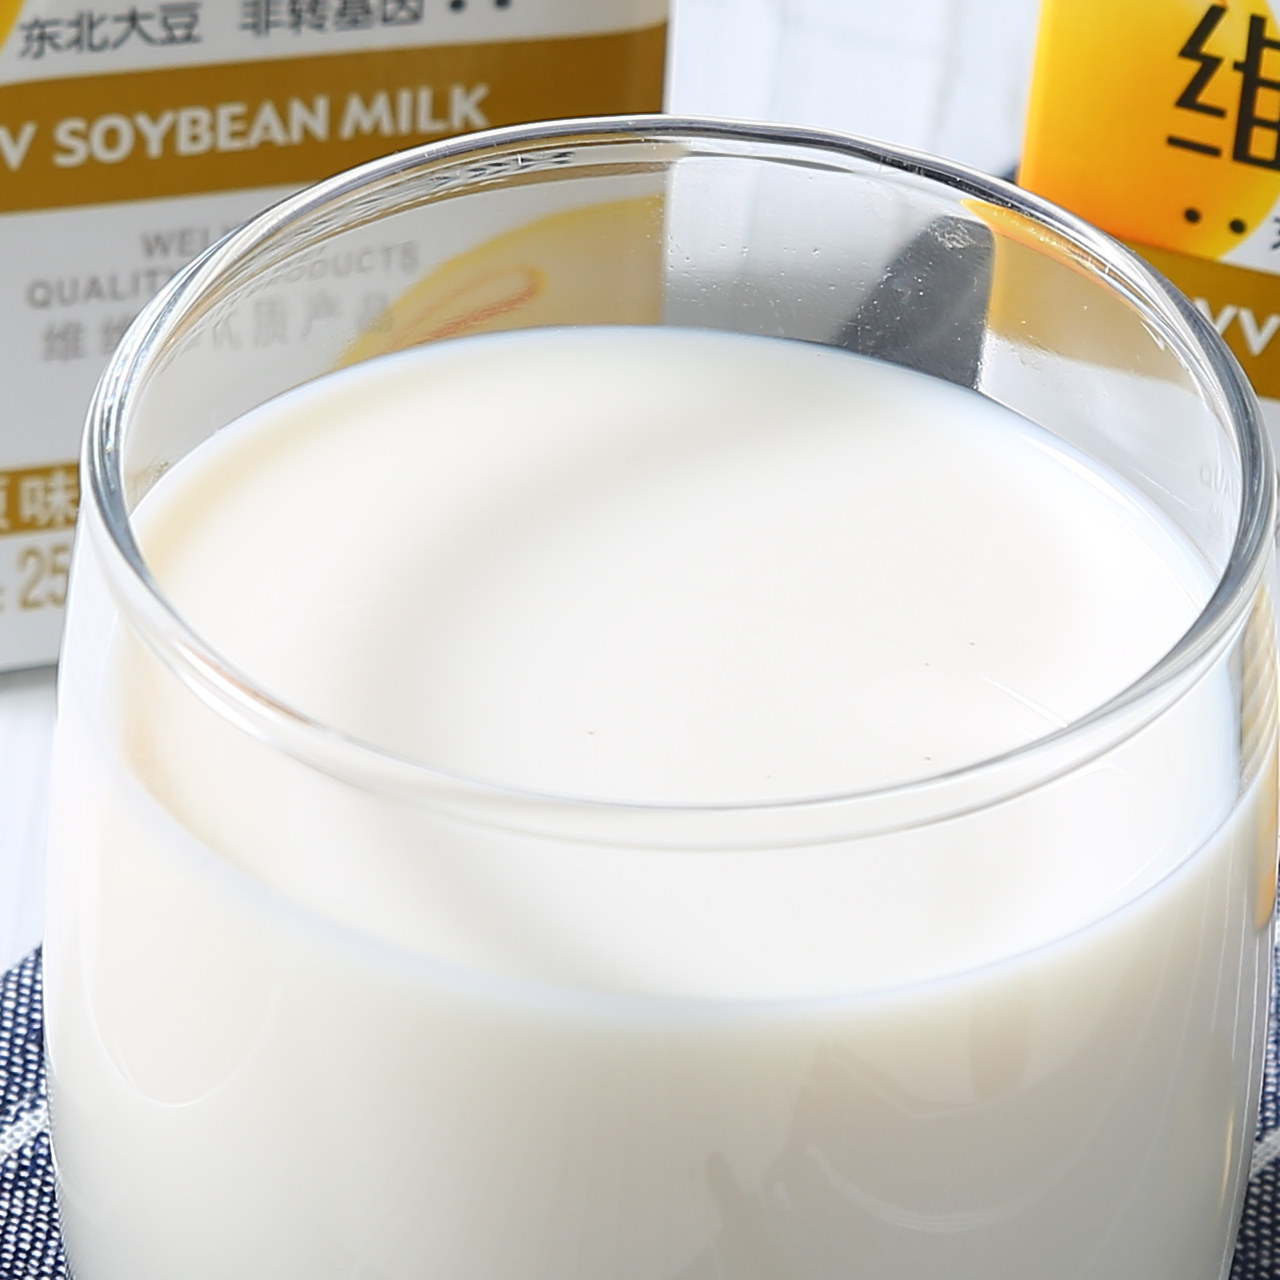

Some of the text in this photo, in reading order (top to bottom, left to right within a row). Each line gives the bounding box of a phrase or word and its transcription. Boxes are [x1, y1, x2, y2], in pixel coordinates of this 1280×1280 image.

[20, 1, 202, 59] 东北大豆
[52, 96, 323, 169] SOYBEAN
[342, 84, 491, 142] MILK
[25, 267, 177, 310] QUALIT
